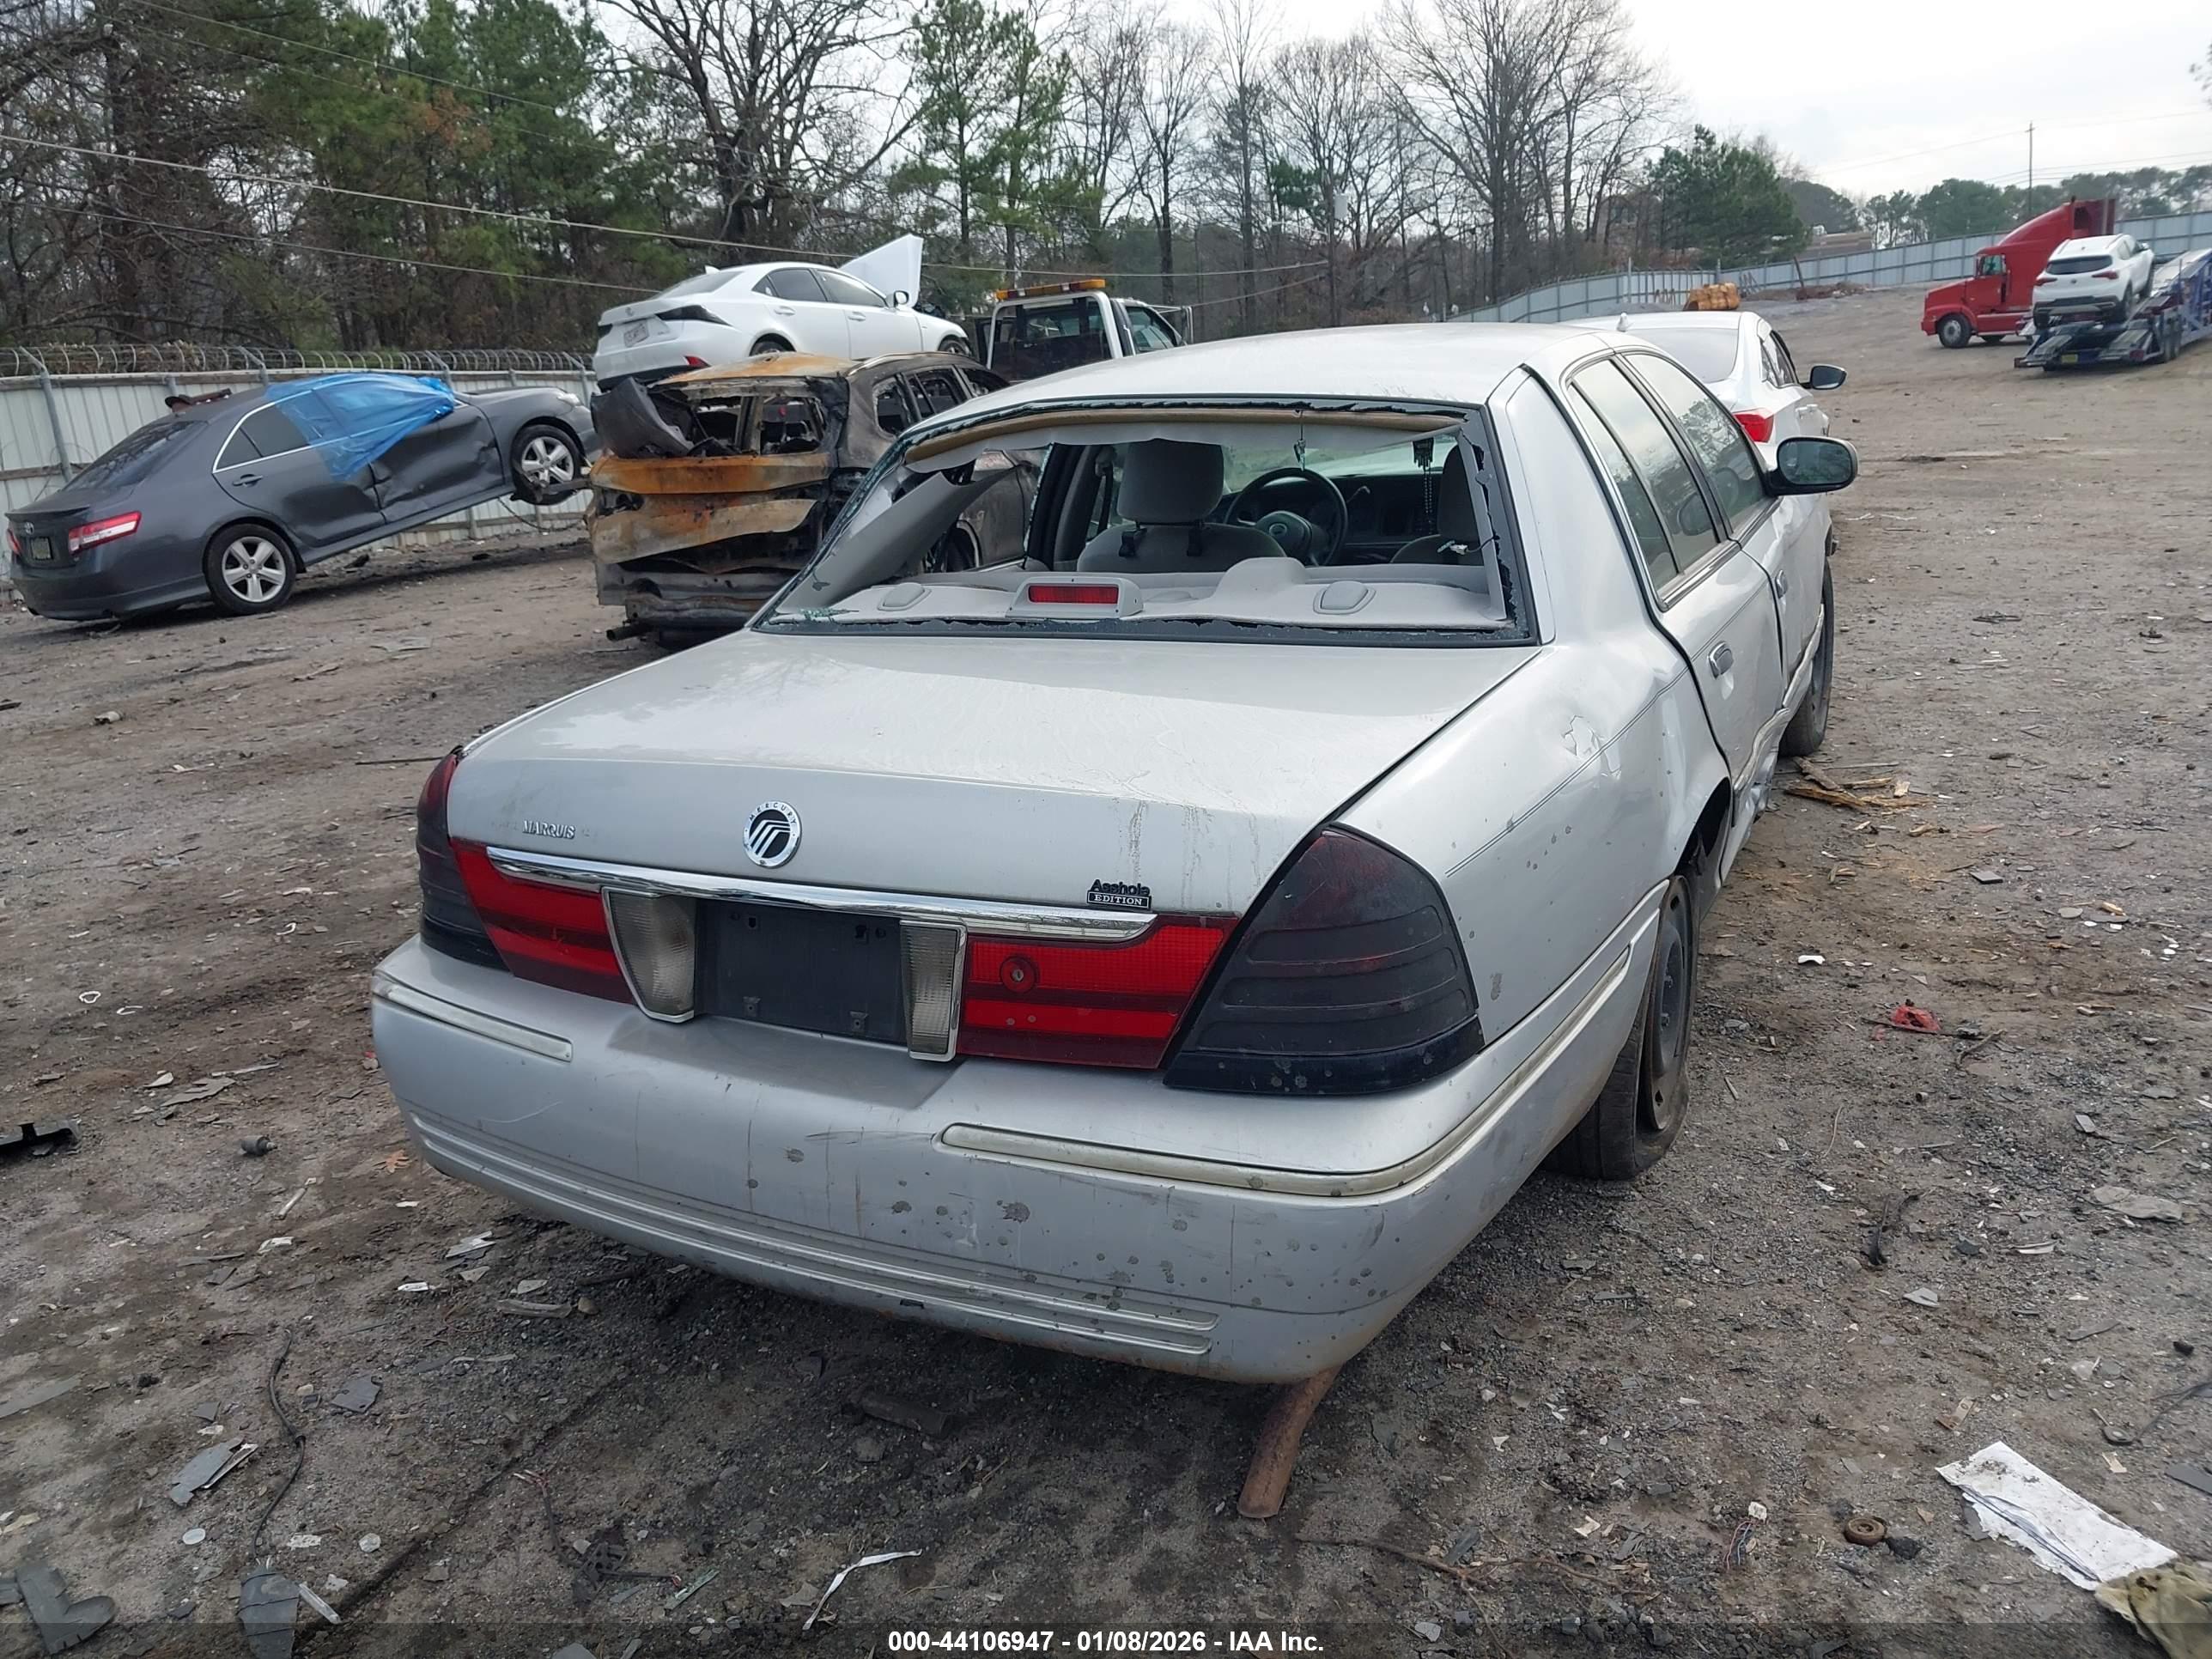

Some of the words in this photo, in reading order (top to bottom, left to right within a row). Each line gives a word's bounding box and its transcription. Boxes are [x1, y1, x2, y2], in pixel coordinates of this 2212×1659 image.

[749, 802, 797, 824] MERCURY
[522, 820, 575, 840] MARQUIS
[1090, 878, 1151, 897] Asshole
[1094, 894, 1143, 906] EDITION
